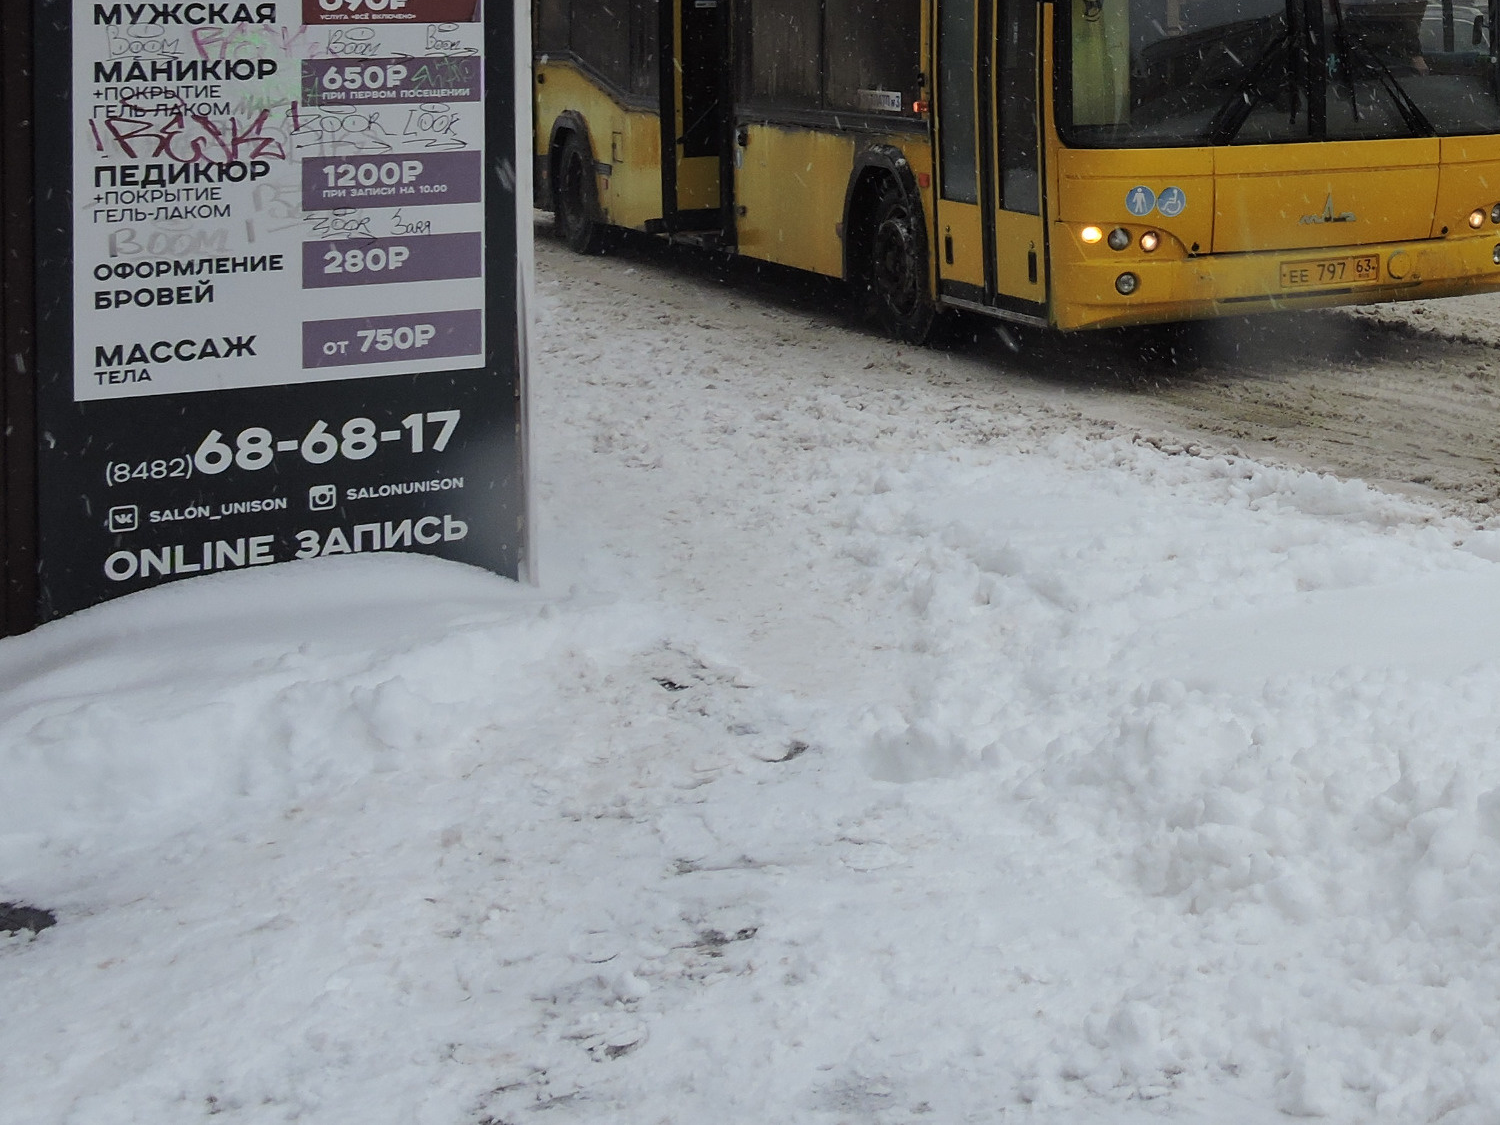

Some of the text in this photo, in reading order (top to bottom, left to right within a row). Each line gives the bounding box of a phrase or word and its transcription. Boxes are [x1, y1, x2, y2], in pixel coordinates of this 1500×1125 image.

[93, 3, 277, 25] МУЖСКАЯ
[93, 58, 278, 83] МАНИКЮР
[322, 64, 408, 90] 650₽
[93, 84, 470, 101] +ПОКРЫТИЕ ПРИ ПЕРВОМ ПОСЕЩЕНИИ
[94, 160, 424, 189] ПЕДИКЮР 1200₽
[94, 184, 448, 205] +ПОКРЫТИЕ ПРИ ЗАПИСИ НА 10.00
[93, 204, 231, 223] ГЕЛЬ-ЛАКОМ
[94, 246, 410, 281] ОФОРМЛЕНИЕ 280₽
[1317, 261, 1346, 281] 797
[1355, 258, 1372, 273] 63
[94, 279, 214, 310] БРОВЕЙ
[95, 335, 257, 367] МАССАЖ
[357, 324, 436, 353] 750₽
[94, 368, 152, 385] ТЕЛА
[149, 497, 288, 523] SALON_UNISON
[346, 477, 464, 501] SALONUNISON
[104, 514, 468, 581] ONLINE ЗАПИСЬ
